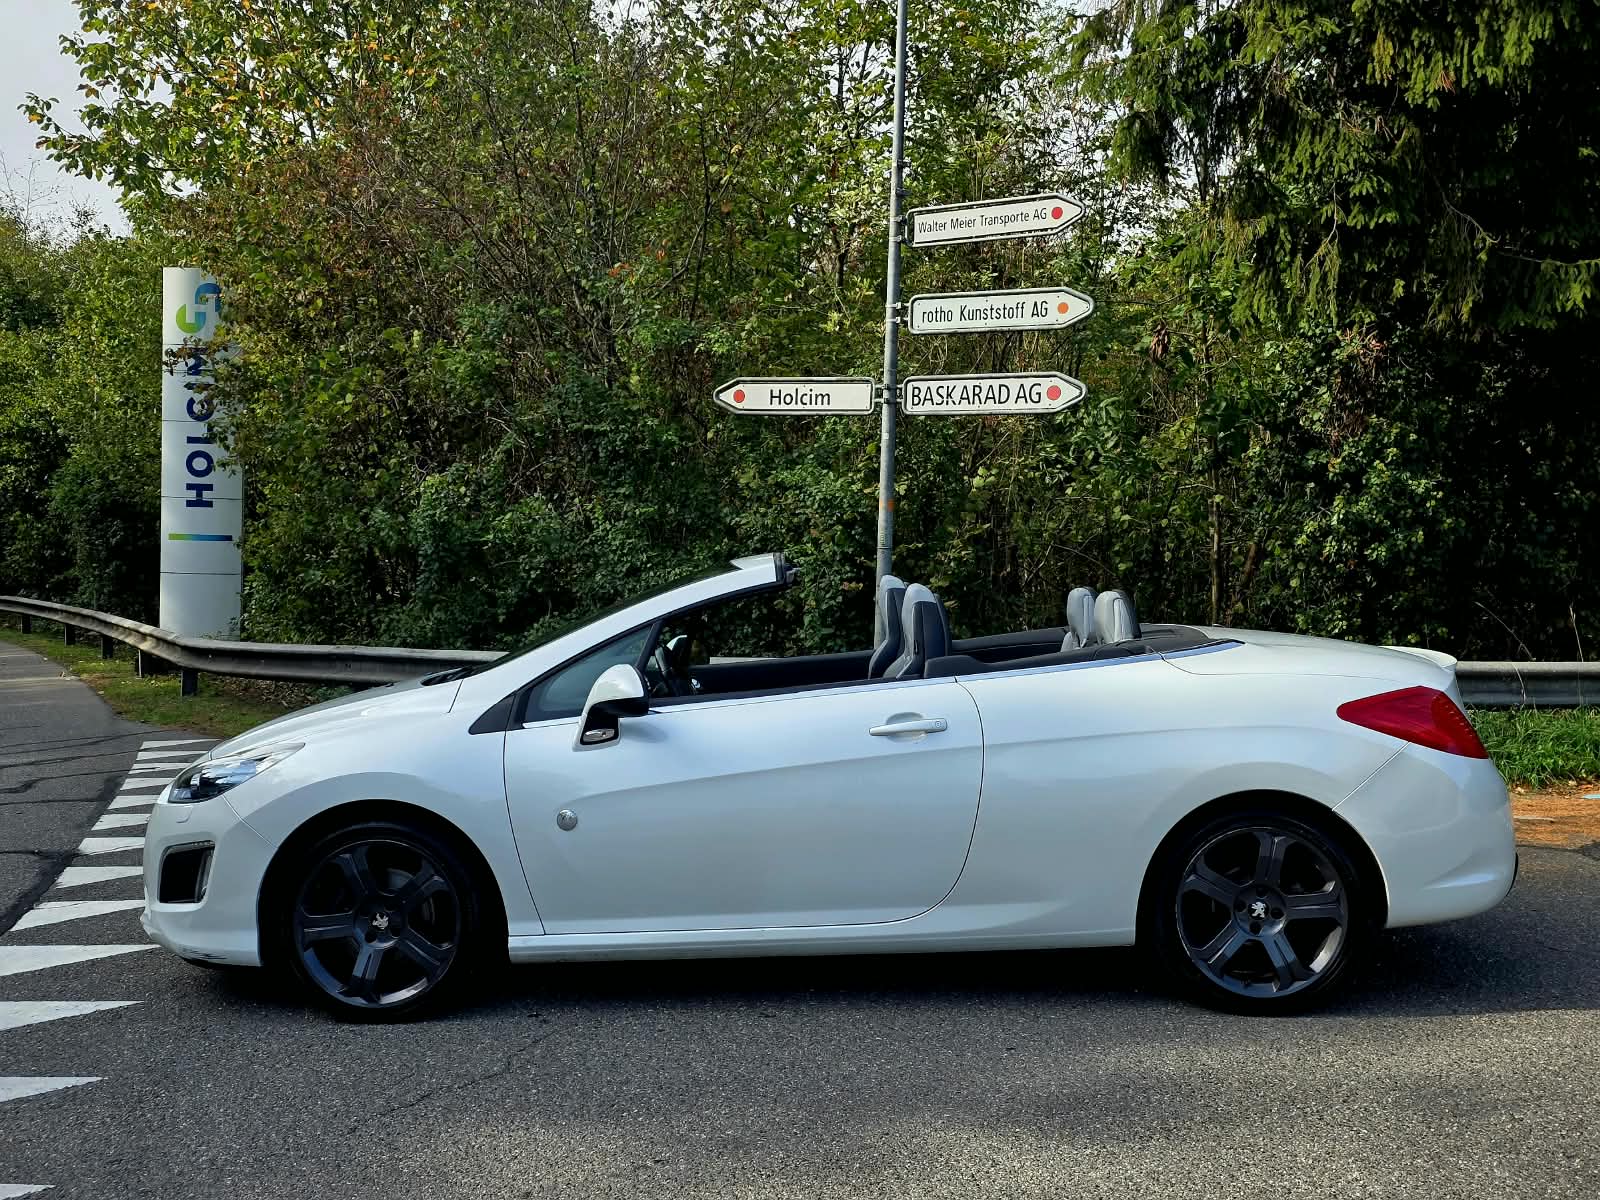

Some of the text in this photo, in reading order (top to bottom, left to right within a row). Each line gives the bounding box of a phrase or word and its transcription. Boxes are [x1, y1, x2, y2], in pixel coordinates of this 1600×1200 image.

[918, 207, 1047, 234] Walter Meier Transporte AG
[922, 301, 1048, 324] rotho Kunststoff AG
[769, 388, 831, 406] Holcim
[911, 383, 1042, 407] BASKARAD AG
